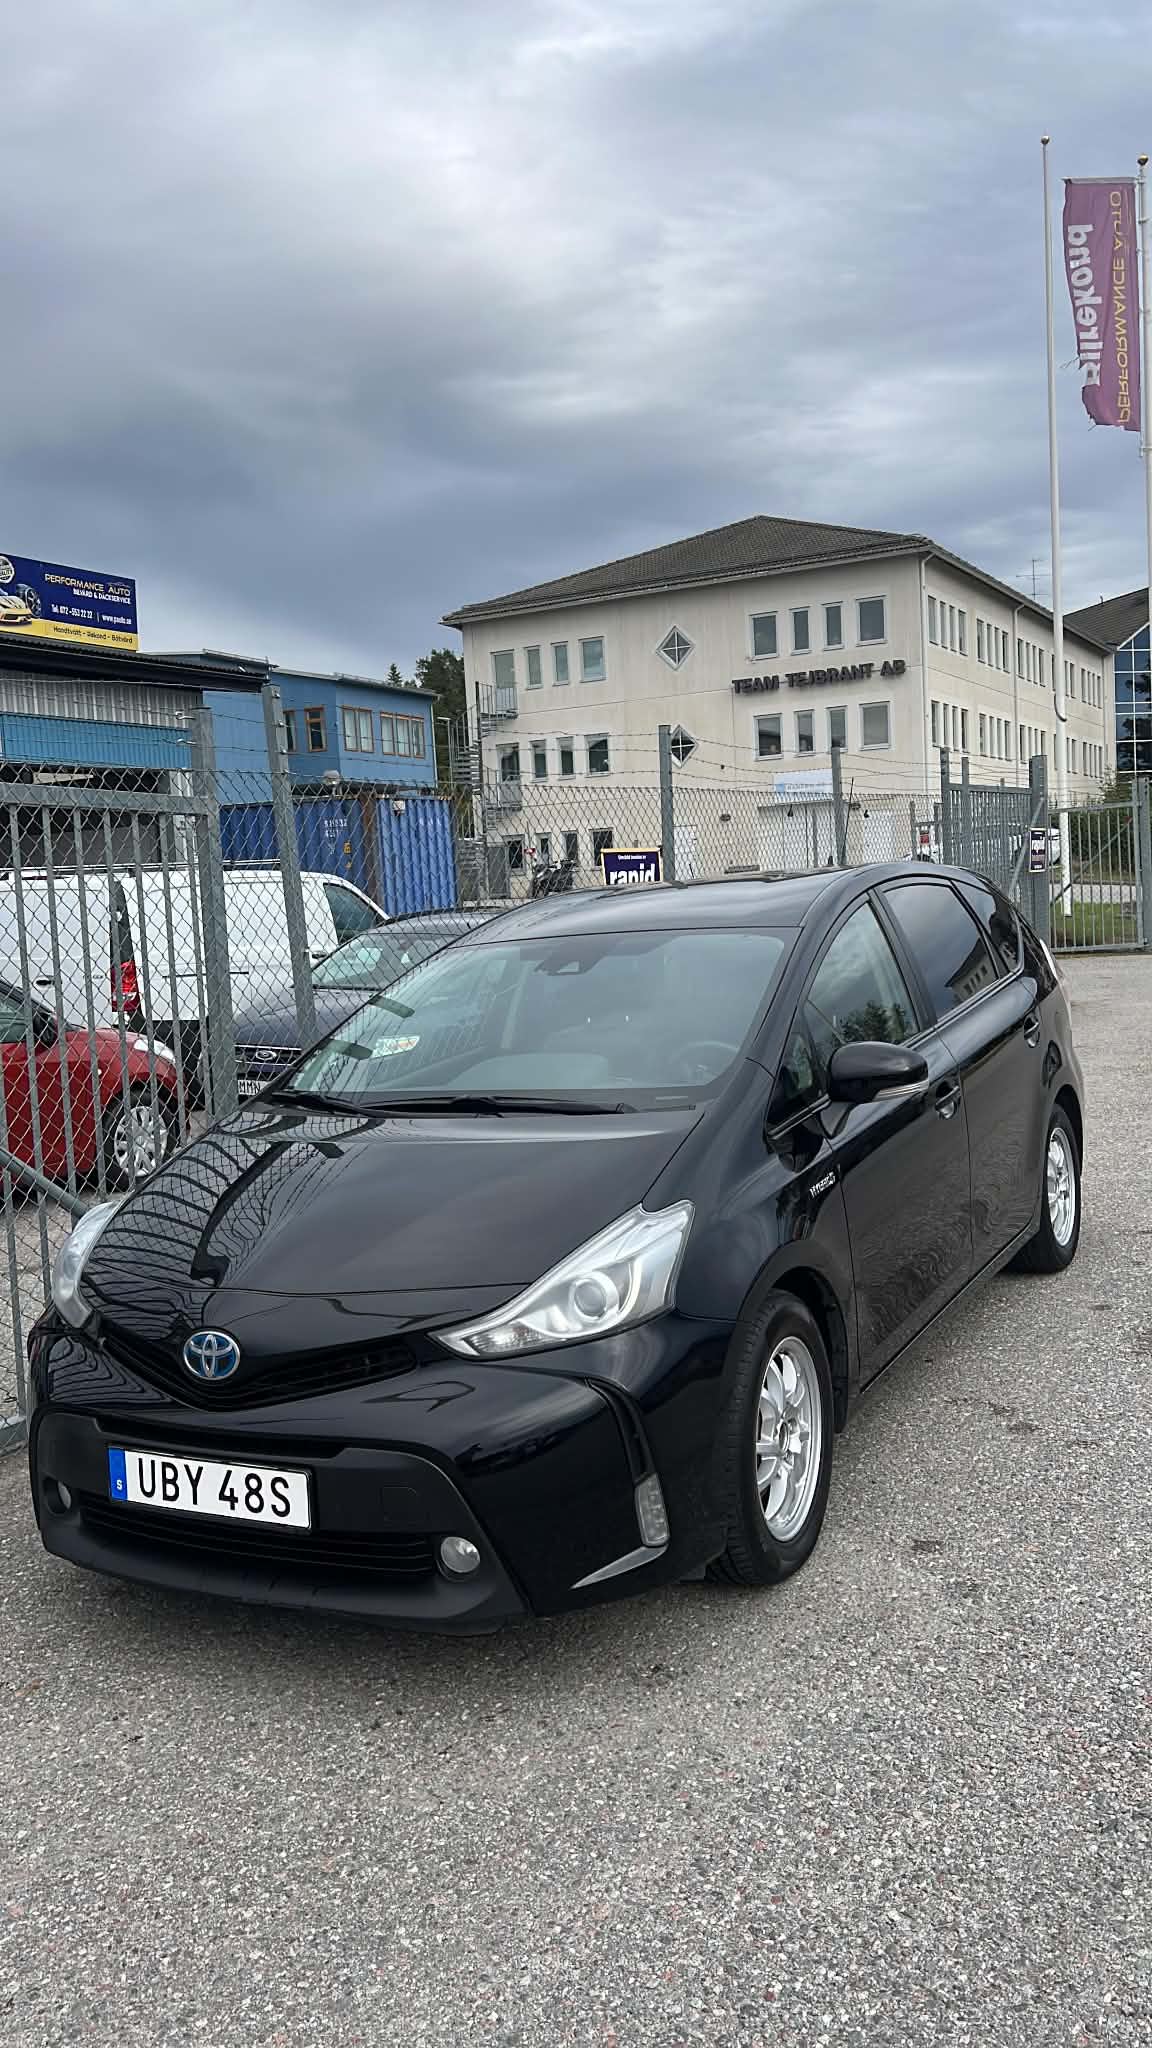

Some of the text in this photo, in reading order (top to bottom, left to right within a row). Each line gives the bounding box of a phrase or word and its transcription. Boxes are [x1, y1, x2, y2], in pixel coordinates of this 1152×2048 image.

[45, 574, 131, 597] PERFORMANCE AUTO
[732, 659, 906, 694] TEAM TEJBRANT AB
[116, 1479, 123, 1491] S
[138, 1457, 291, 1518] UBY 48S
